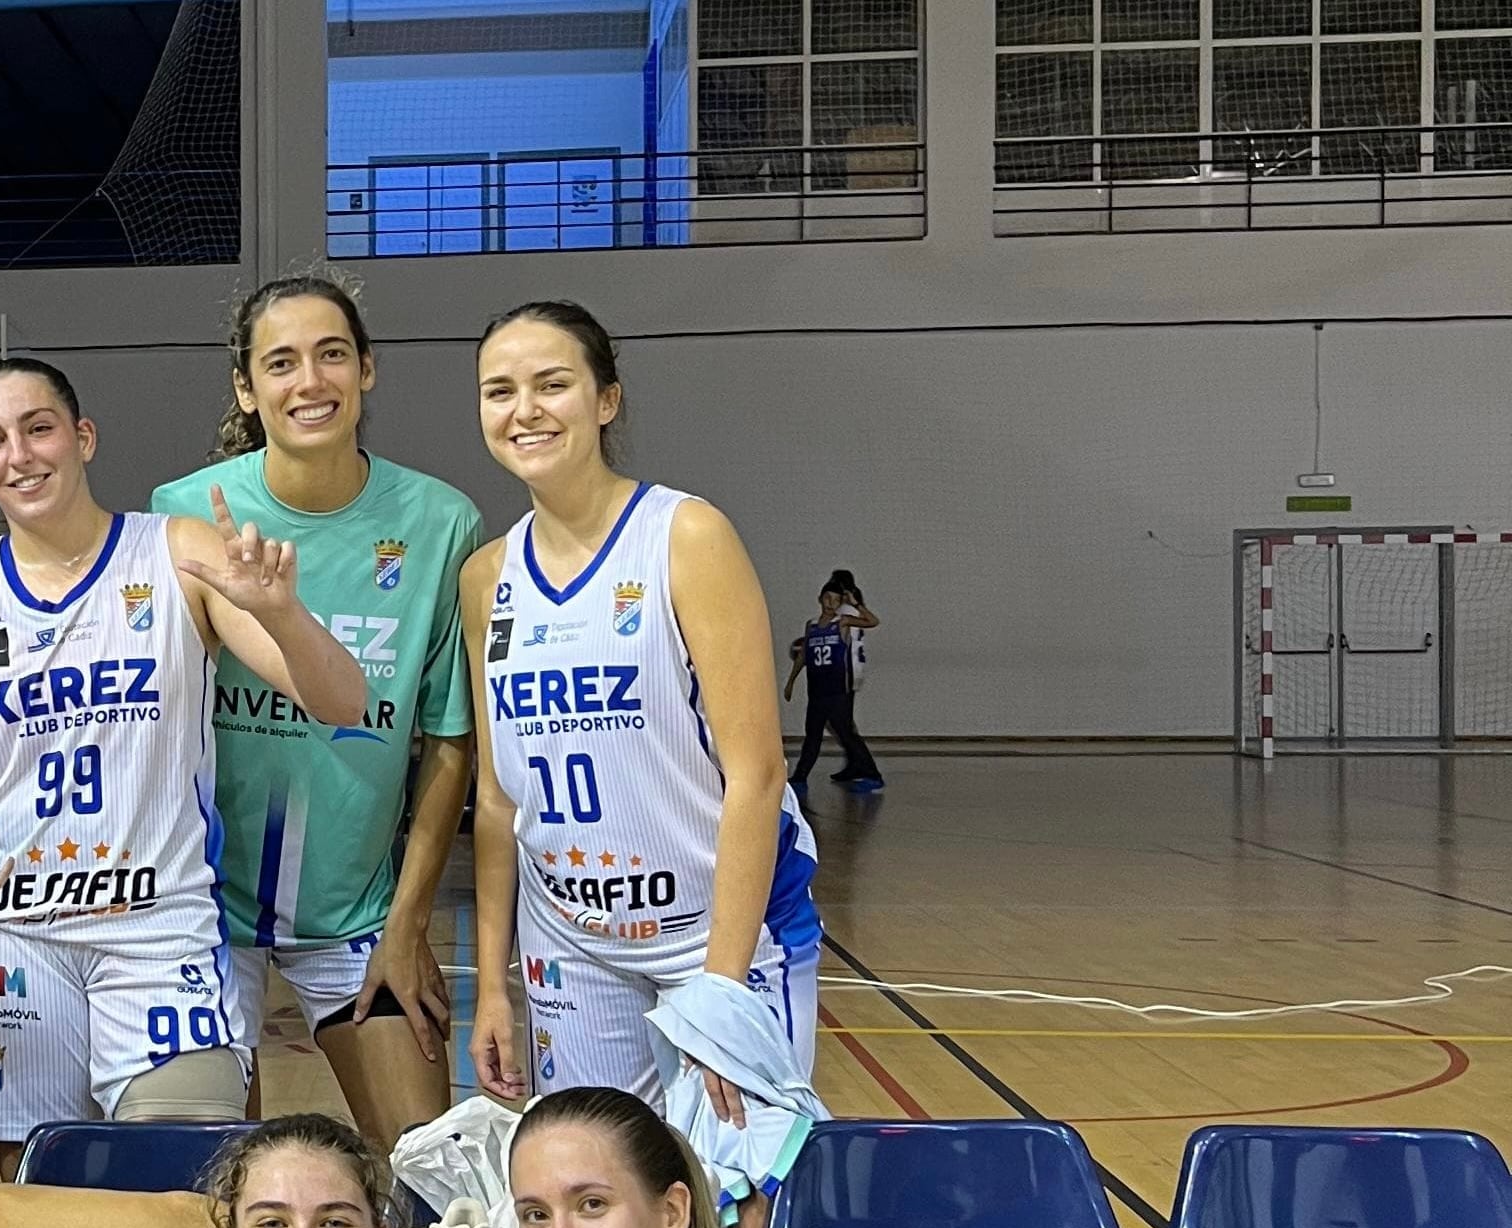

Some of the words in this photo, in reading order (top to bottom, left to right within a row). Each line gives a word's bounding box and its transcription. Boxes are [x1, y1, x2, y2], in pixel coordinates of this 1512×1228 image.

[814, 645, 832, 666] 32
[490, 665, 642, 721] XEREZ
[64, 706, 161, 730] DEPORTIVO
[255, 724, 267, 735] de
[269, 726, 308, 739] alquiler
[548, 714, 645, 735] DEPORTIVO
[36, 744, 103, 819] 99
[528, 753, 602, 824] 10
[526, 955, 562, 990] MM
[147, 1006, 221, 1068] 99
